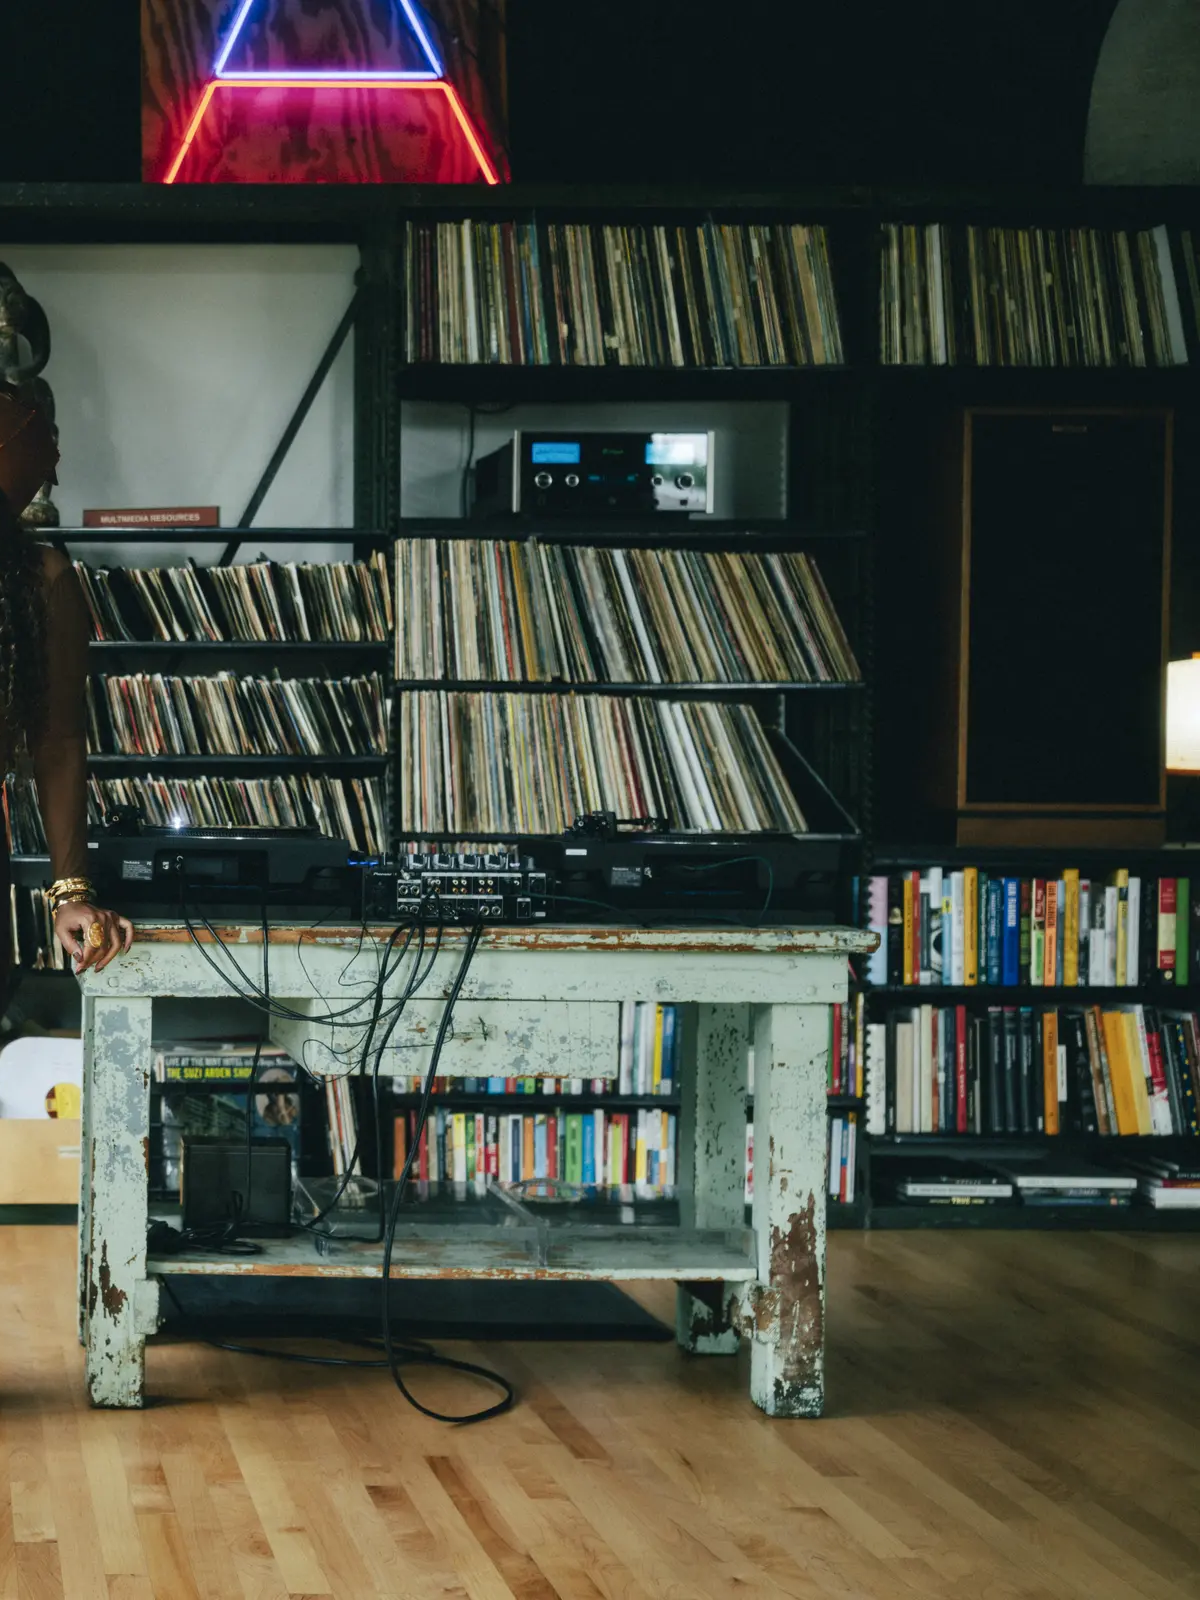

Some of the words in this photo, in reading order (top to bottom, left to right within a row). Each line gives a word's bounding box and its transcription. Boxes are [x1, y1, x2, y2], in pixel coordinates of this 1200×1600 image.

[100, 513, 149, 524] MULTIMEDIA
[150, 512, 201, 522] RESOURCES
[167, 1067, 181, 1078] THE
[183, 1067, 202, 1078] SUZI
[205, 1067, 231, 1078] ARDEN
